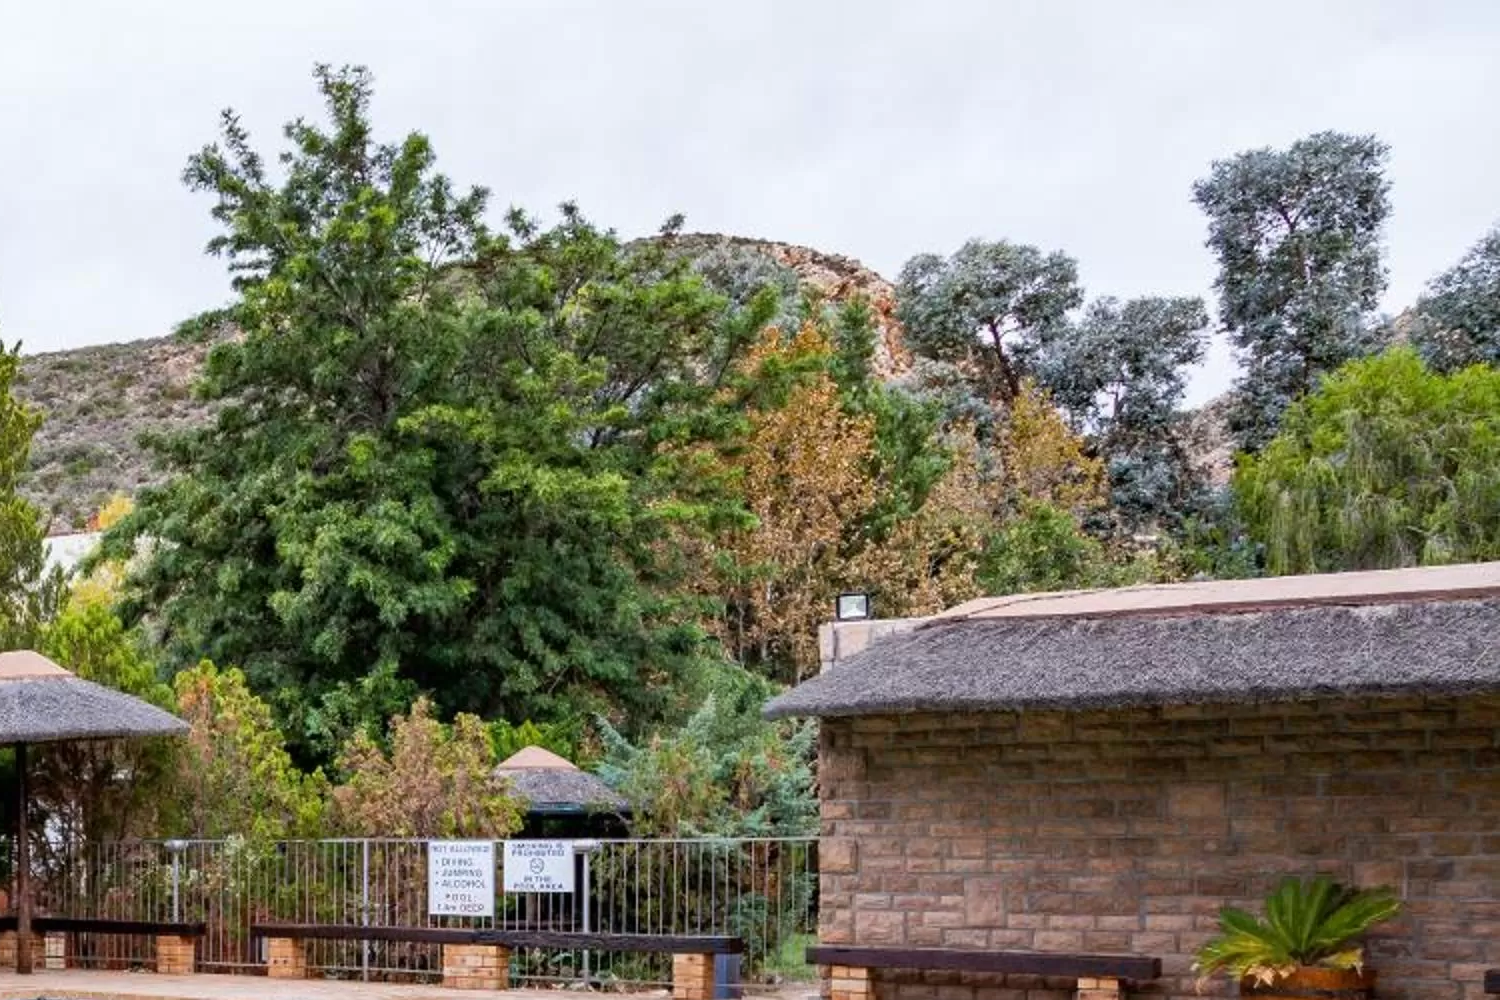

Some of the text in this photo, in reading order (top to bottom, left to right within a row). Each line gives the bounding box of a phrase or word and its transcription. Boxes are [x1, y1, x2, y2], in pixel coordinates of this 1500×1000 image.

[441, 857, 473, 866] DIVING
[441, 868, 483, 877] JUMPING
[441, 879, 486, 889] ALCOHOL
